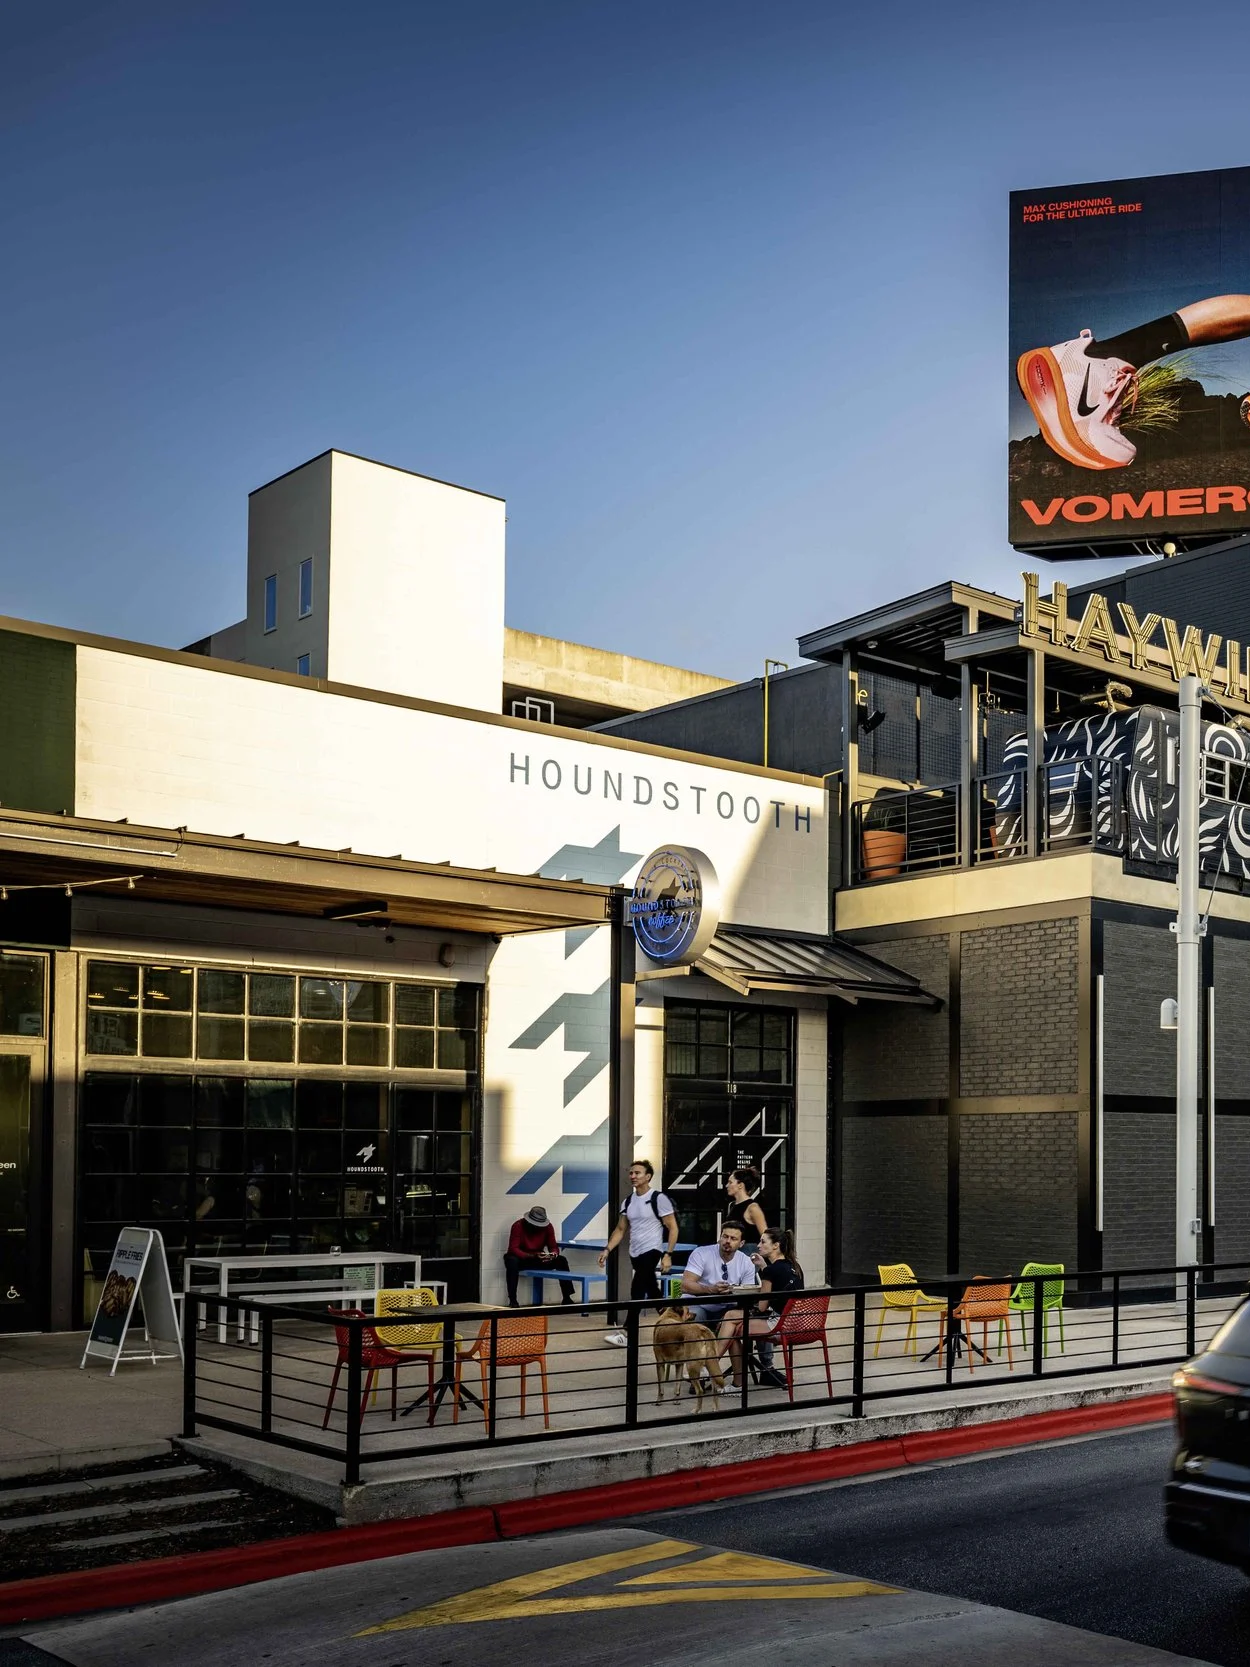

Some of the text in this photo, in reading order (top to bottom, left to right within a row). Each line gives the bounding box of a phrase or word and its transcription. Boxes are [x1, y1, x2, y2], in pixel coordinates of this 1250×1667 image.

[1023, 197, 1113, 214] MAX CUSHIONING
[1023, 203, 1143, 223] FOR THE ULTIMATE RIDE
[509, 752, 811, 834] HOUNDSTOOTH
